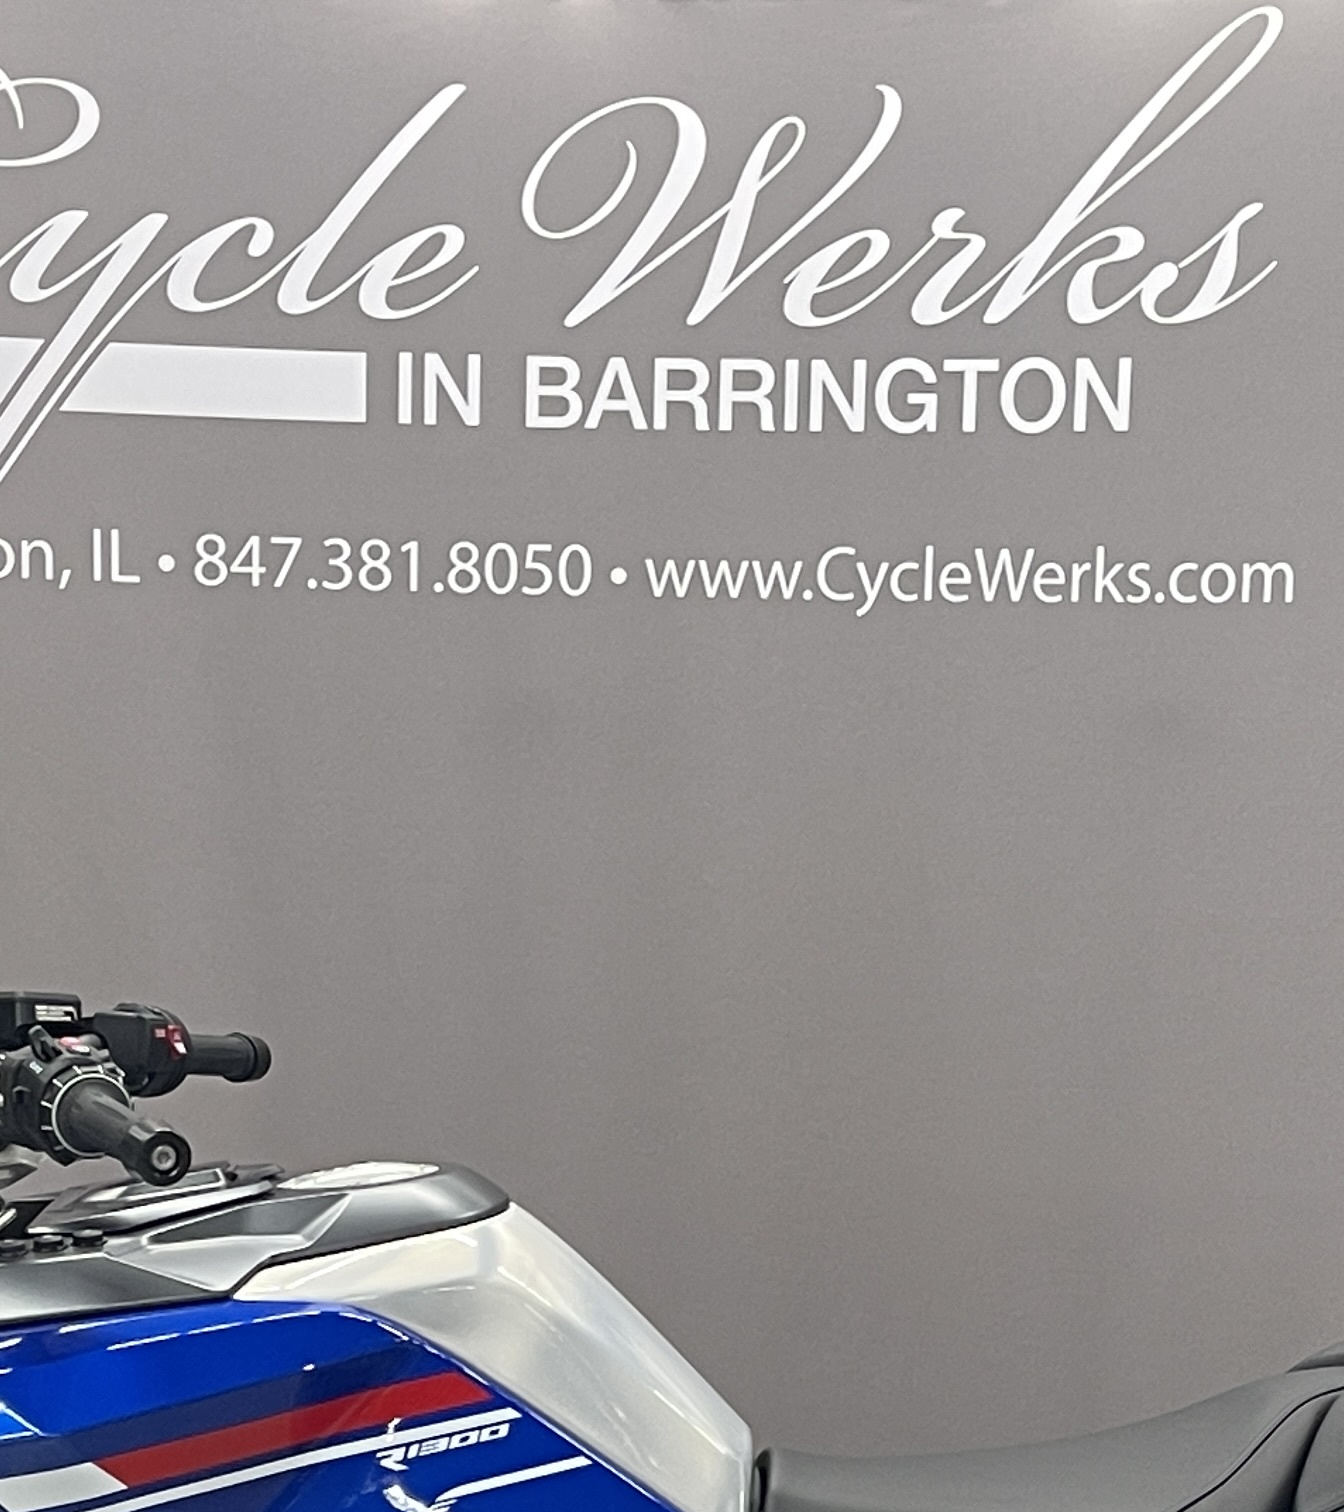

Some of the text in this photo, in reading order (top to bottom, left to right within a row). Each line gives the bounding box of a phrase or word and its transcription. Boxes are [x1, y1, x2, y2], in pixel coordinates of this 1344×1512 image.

[521, 6, 1284, 328] Werks
[397, 351, 1133, 434] IN BARRINGTON
[92, 528, 141, 584] IL
[193, 533, 593, 598] 847.381.8050
[644, 545, 1295, 618] www.CycleWerks.com
